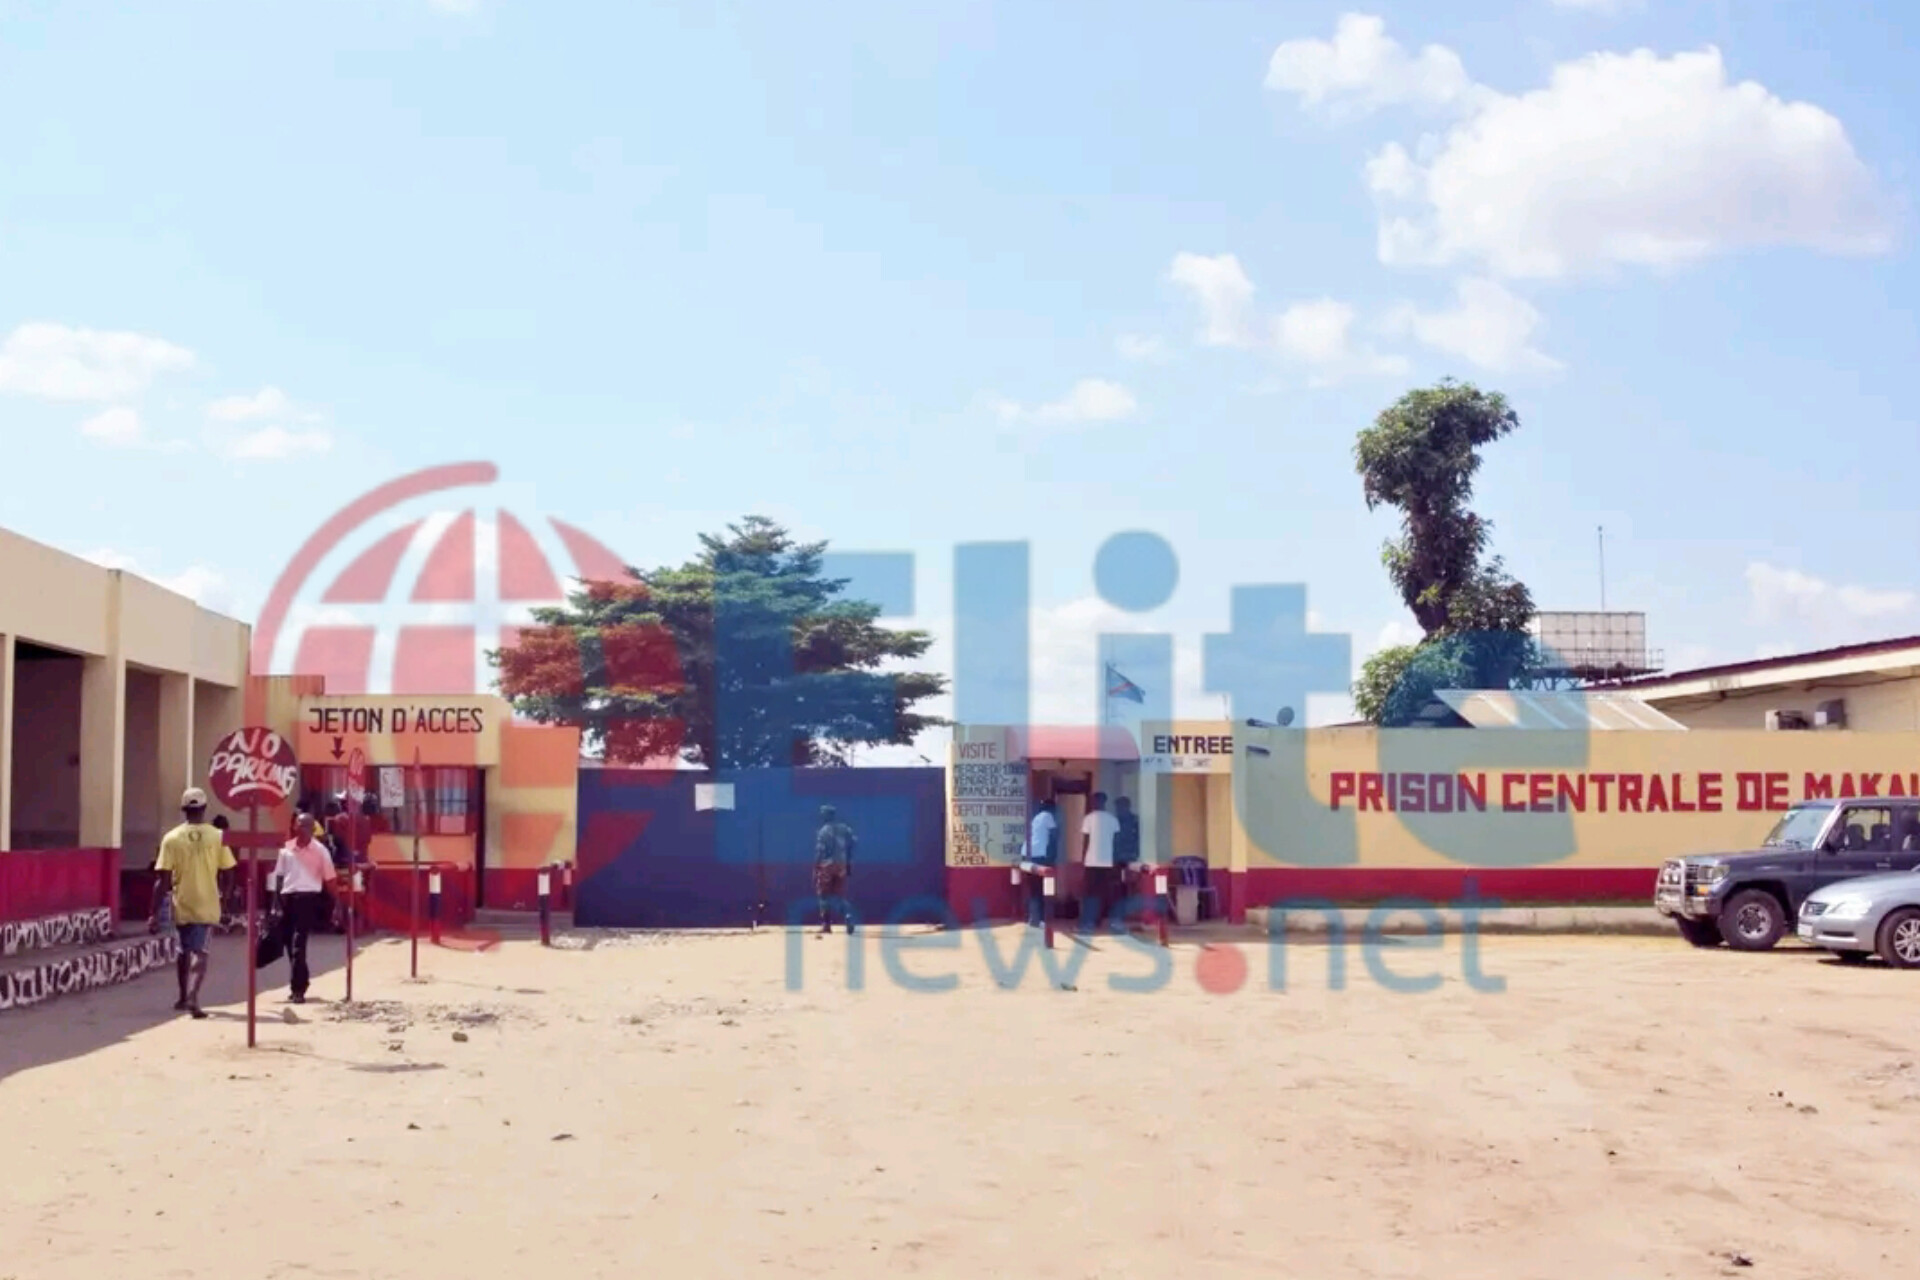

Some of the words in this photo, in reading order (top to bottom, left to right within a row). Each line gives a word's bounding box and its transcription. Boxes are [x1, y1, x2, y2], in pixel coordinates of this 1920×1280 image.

[309, 708, 383, 733] JETON
[391, 706, 483, 733] D'ACCES
[228, 728, 280, 758] NO
[959, 742, 997, 759] VISITE
[1154, 735, 1234, 754] ENTREE
[209, 752, 297, 795] PARKING
[1330, 772, 1487, 812] PRISON
[1502, 773, 1723, 812] CENTRALE
[1736, 772, 1789, 812] DE
